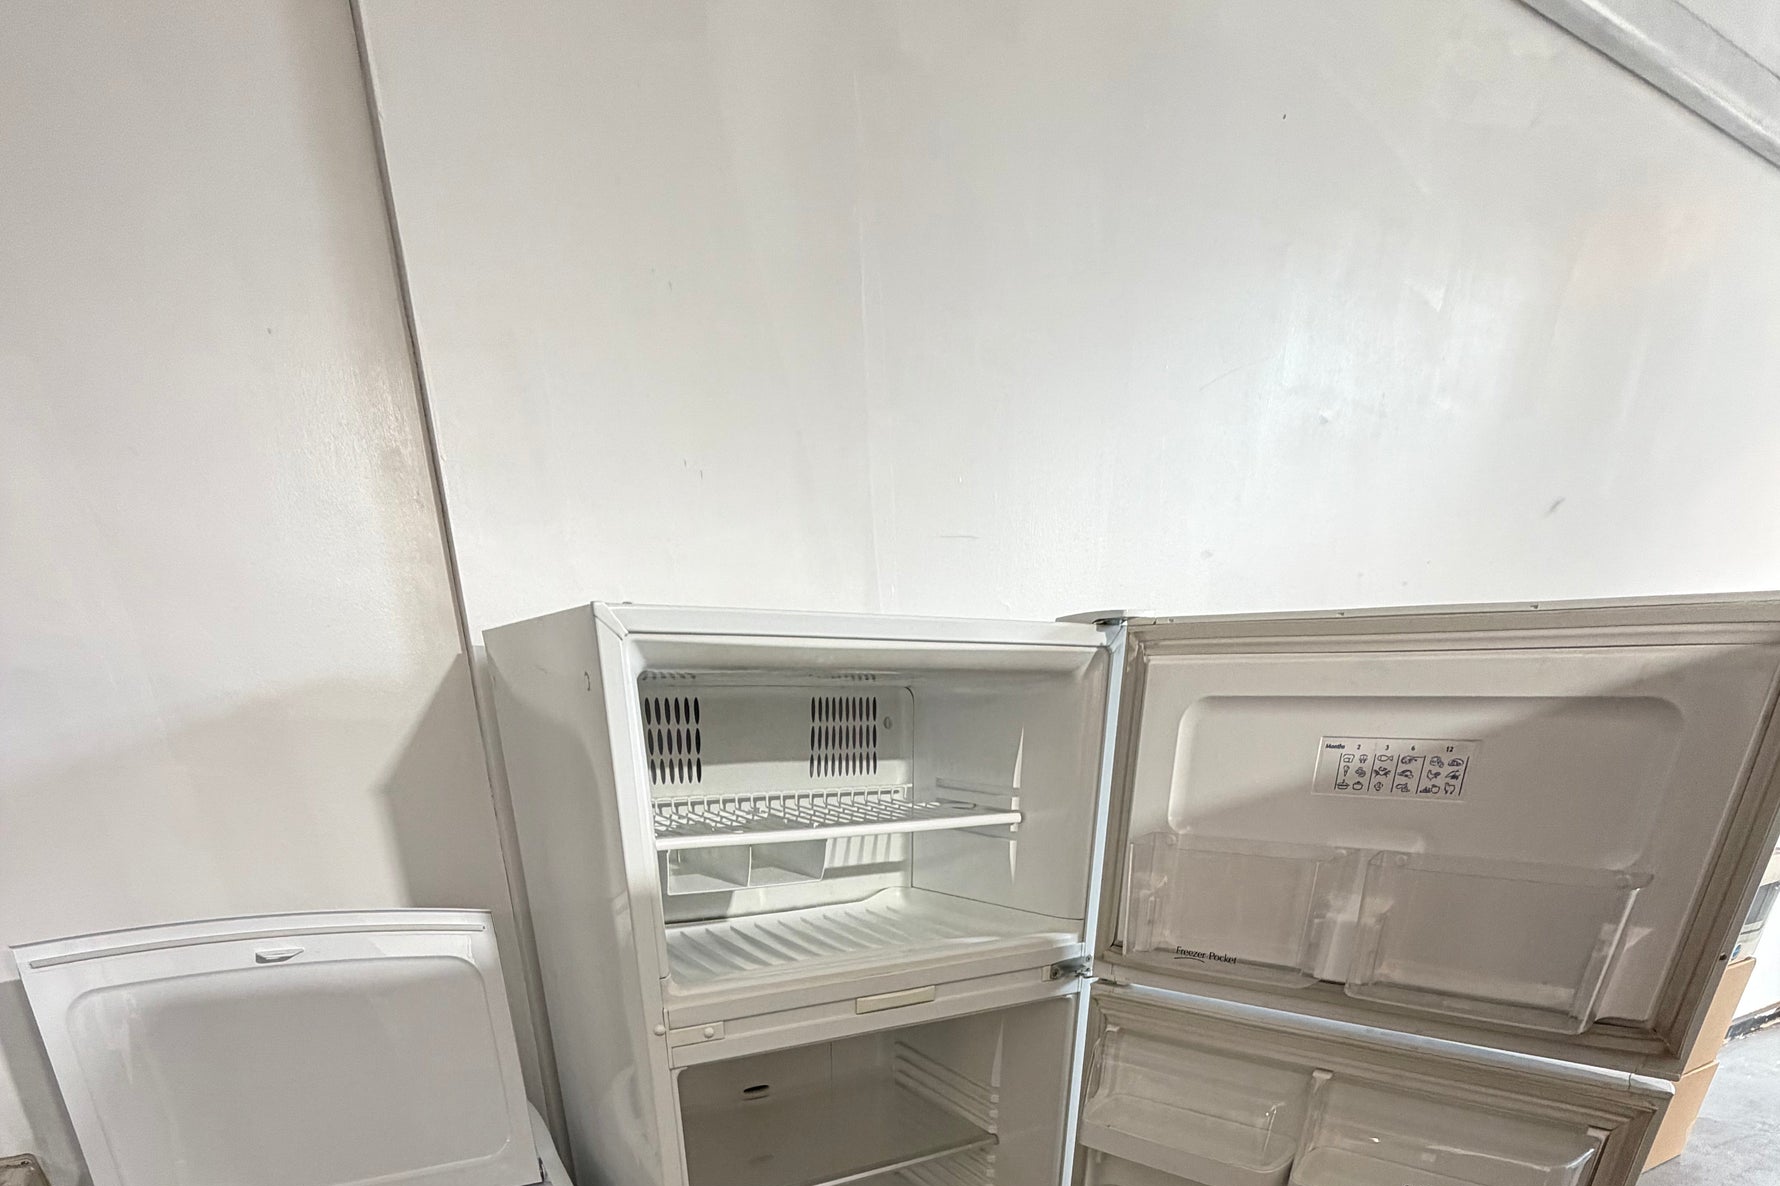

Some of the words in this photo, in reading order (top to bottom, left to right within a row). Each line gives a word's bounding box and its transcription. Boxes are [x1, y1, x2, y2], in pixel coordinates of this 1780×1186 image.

[1446, 745, 1454, 753] 12
[1176, 946, 1206, 959] Freezer
[1208, 952, 1237, 964] Pocket
